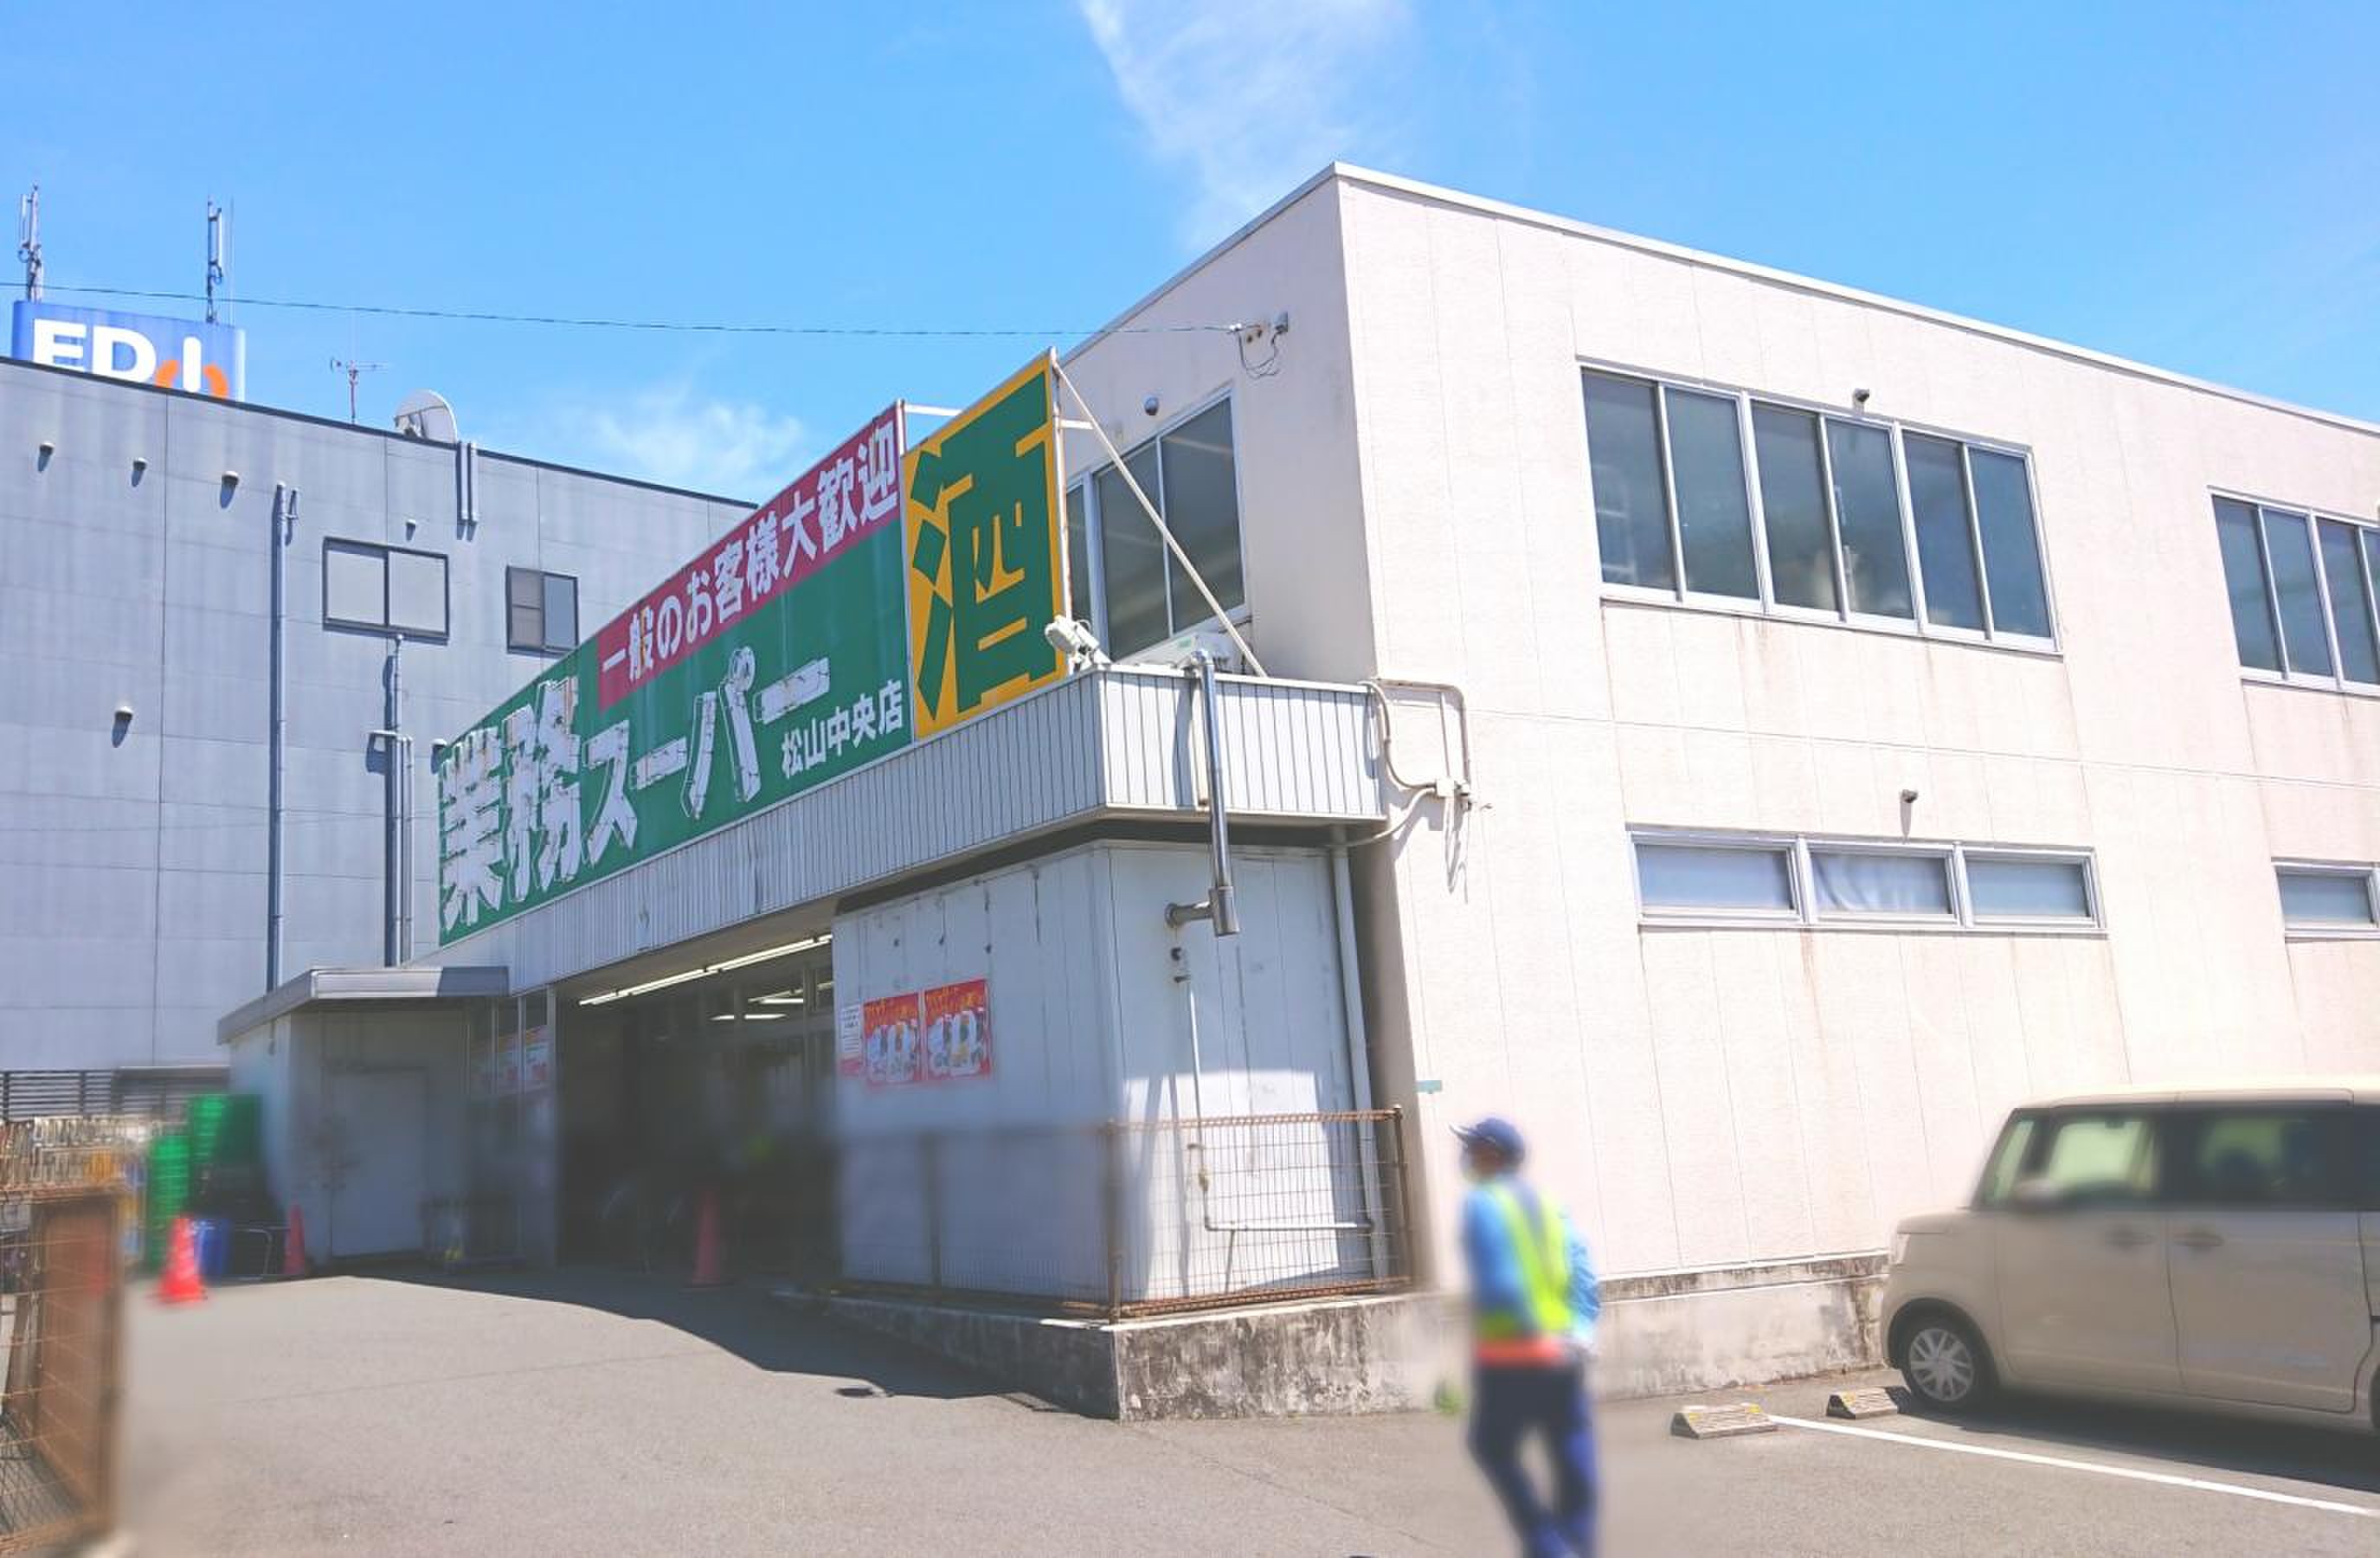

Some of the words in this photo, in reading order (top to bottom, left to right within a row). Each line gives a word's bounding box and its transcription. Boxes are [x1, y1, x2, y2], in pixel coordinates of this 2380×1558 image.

[602, 421, 897, 681] 一般のお客様大歓迎
[910, 371, 1057, 721] 酒
[437, 646, 831, 931] 業務スーパー
[782, 679, 902, 779] 松山中央店
